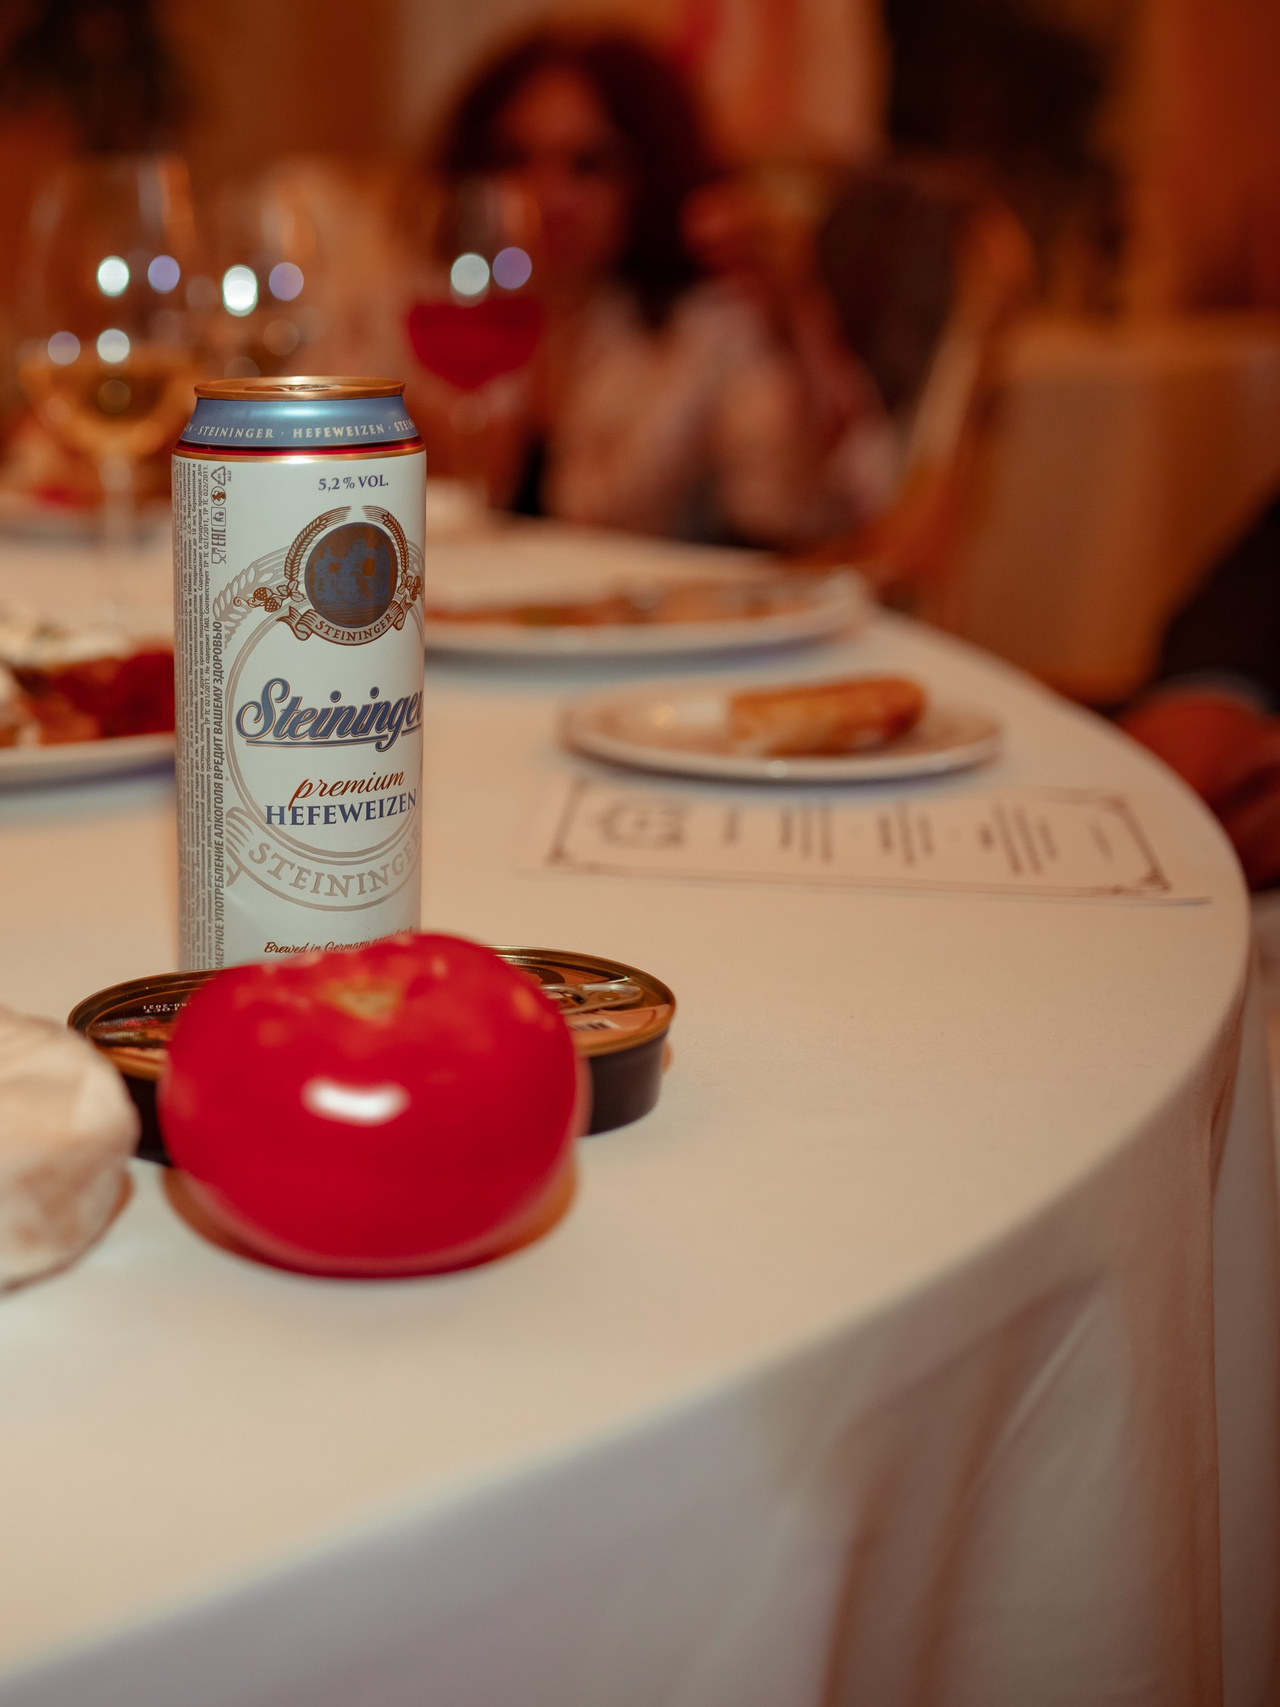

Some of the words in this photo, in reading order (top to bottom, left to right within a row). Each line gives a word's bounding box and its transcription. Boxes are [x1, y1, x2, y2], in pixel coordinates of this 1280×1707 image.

[198, 425, 274, 439] STEININGER
[293, 423, 385, 438] HEFEWEIZEN
[318, 477, 340, 492] 5,2
[357, 474, 389, 488] VOL.
[315, 613, 394, 642] STEININGER
[213, 621, 224, 685] ЗДОРОВЬЮ
[213, 686, 224, 736] ВАШЕМУ
[213, 736, 224, 781] ВРЕДИТ
[213, 782, 224, 840] АЛКОГОЛЯ
[265, 788, 417, 826] HEFEWEIZEN
[288, 770, 405, 812] premium
[214, 840, 224, 922] УПОТРЕБЛЕНИЕ
[248, 825, 420, 898] STEININGER
[214, 923, 224, 969] МЕРНОЕ
[264, 941, 310, 954] Brewed
[311, 942, 322, 953] in
